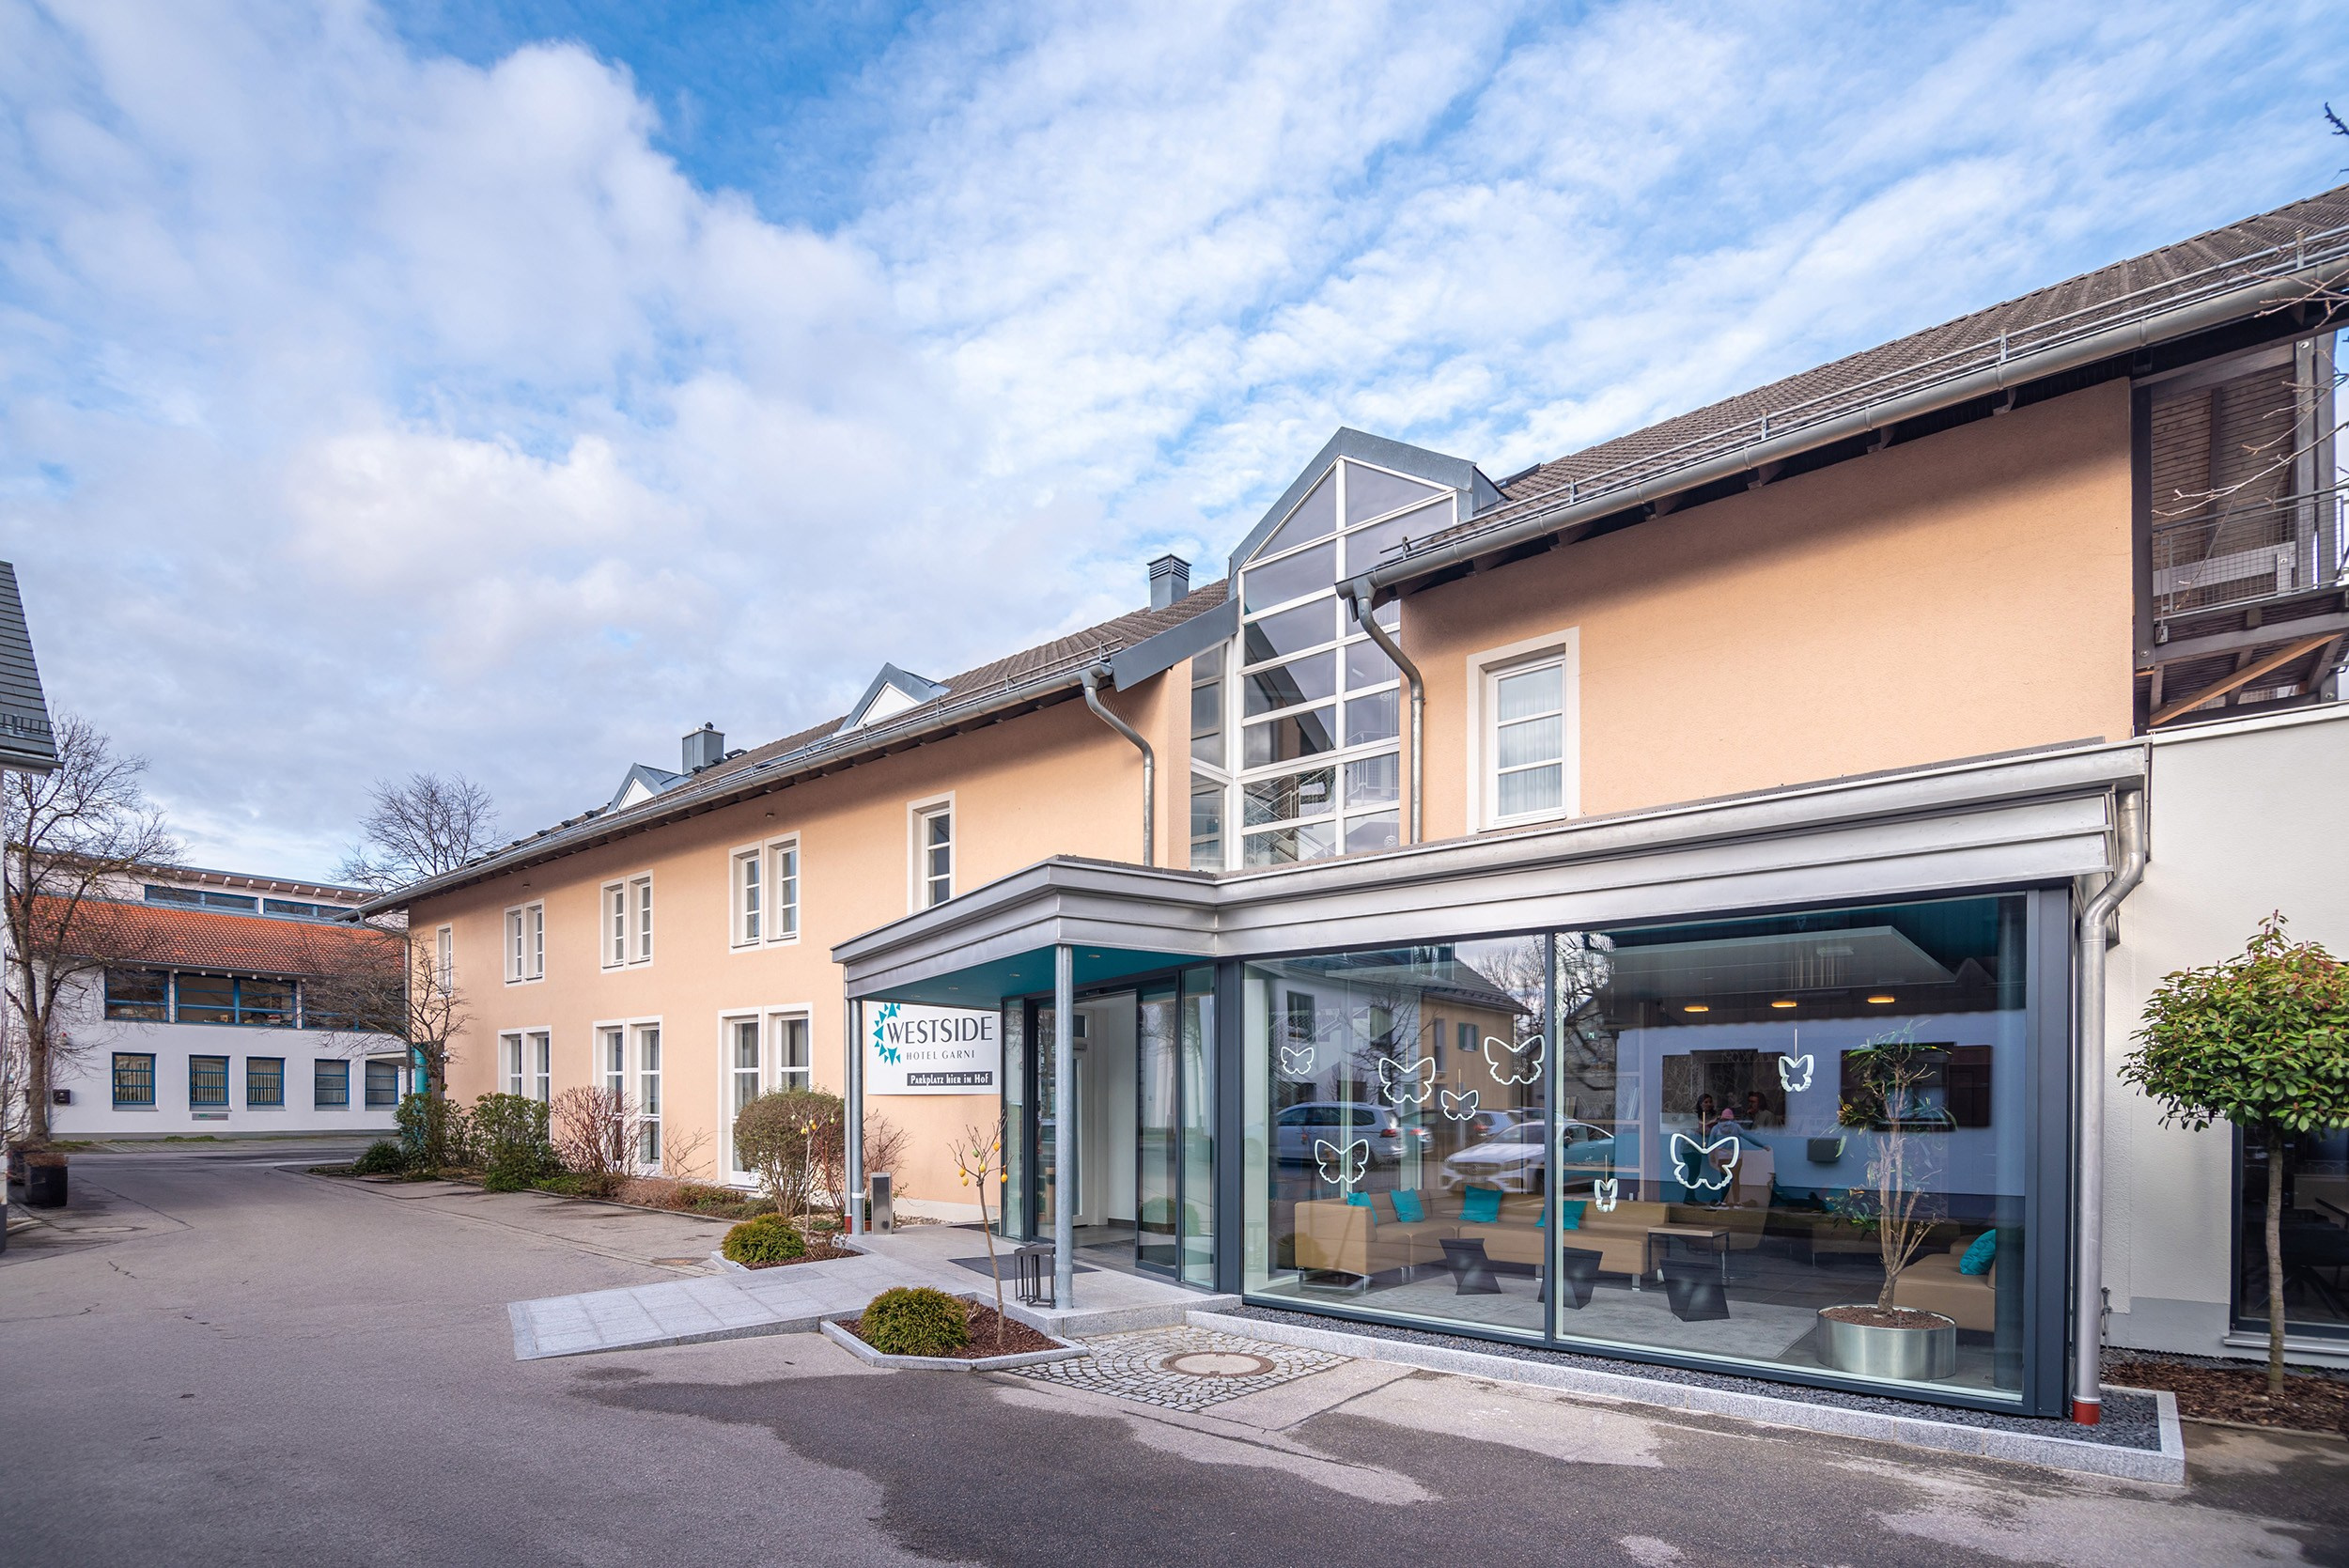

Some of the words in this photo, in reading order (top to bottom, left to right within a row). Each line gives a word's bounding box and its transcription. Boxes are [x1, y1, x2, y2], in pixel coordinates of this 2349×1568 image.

[887, 1017, 992, 1044] WESTSIDE
[907, 1051, 938, 1060] HOTEL
[942, 1049, 974, 1059] GARNI
[974, 1073, 988, 1084] Hof
